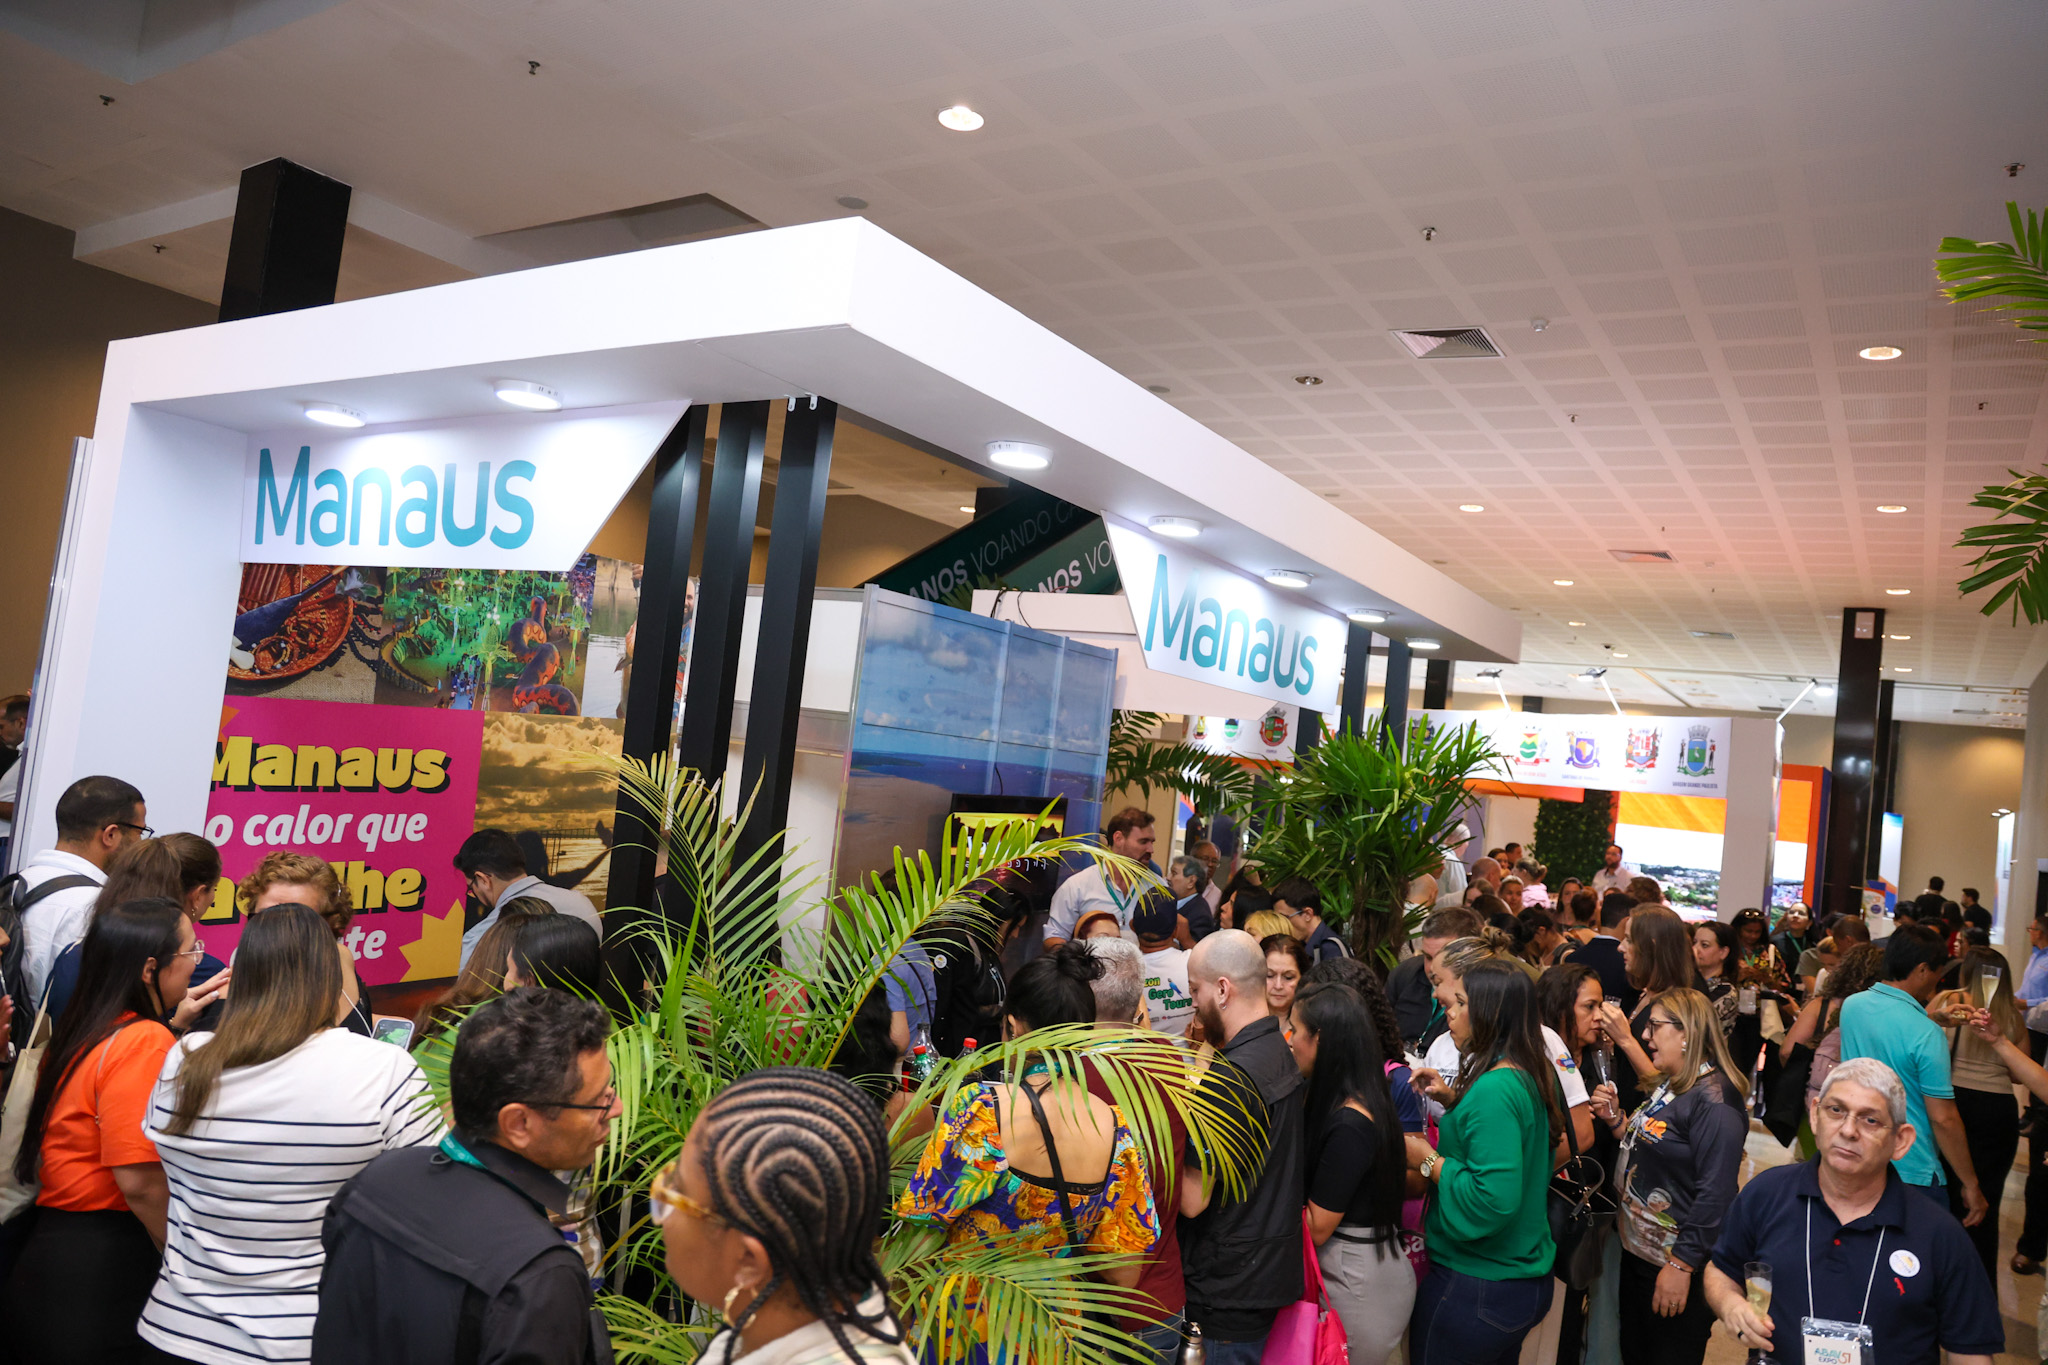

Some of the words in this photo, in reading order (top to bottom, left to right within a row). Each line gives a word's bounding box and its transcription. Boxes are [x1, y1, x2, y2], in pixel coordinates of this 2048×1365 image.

[255, 446, 536, 549] Manaus
[970, 510, 1050, 574] VOANDO
[1037, 559, 1082, 593] NOS
[1144, 554, 1318, 695] Manaus
[211, 736, 449, 791] Manaus
[204, 815, 234, 847] o
[243, 804, 354, 846] calor
[357, 813, 428, 853] que
[1148, 988, 1174, 1000] Gero
